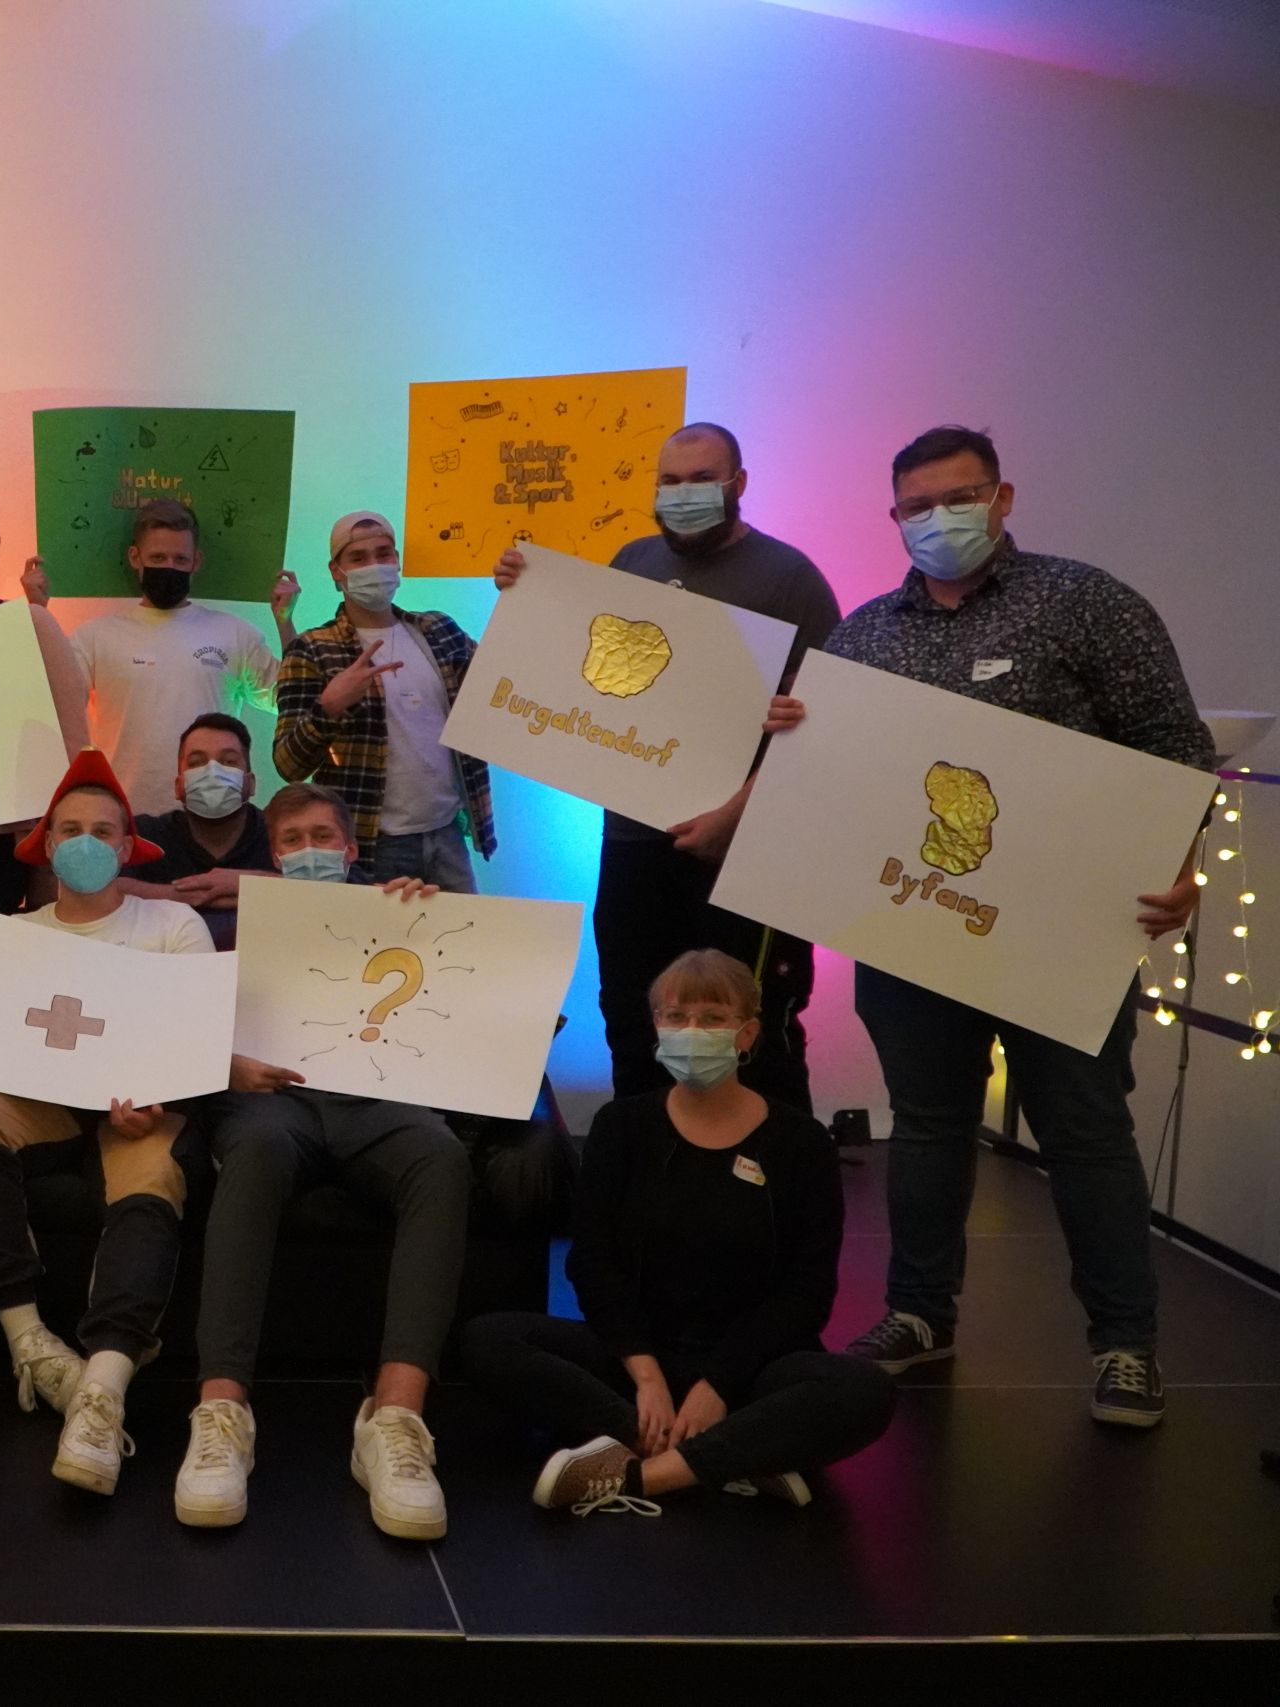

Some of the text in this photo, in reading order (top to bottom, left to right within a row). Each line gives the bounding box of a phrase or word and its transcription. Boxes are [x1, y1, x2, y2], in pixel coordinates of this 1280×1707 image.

[121, 467, 183, 489] Natur
[506, 459, 567, 485] Musik
[513, 480, 575, 515] Sport
[489, 676, 680, 767] Burgaltendorf
[880, 857, 999, 936] Byfang
